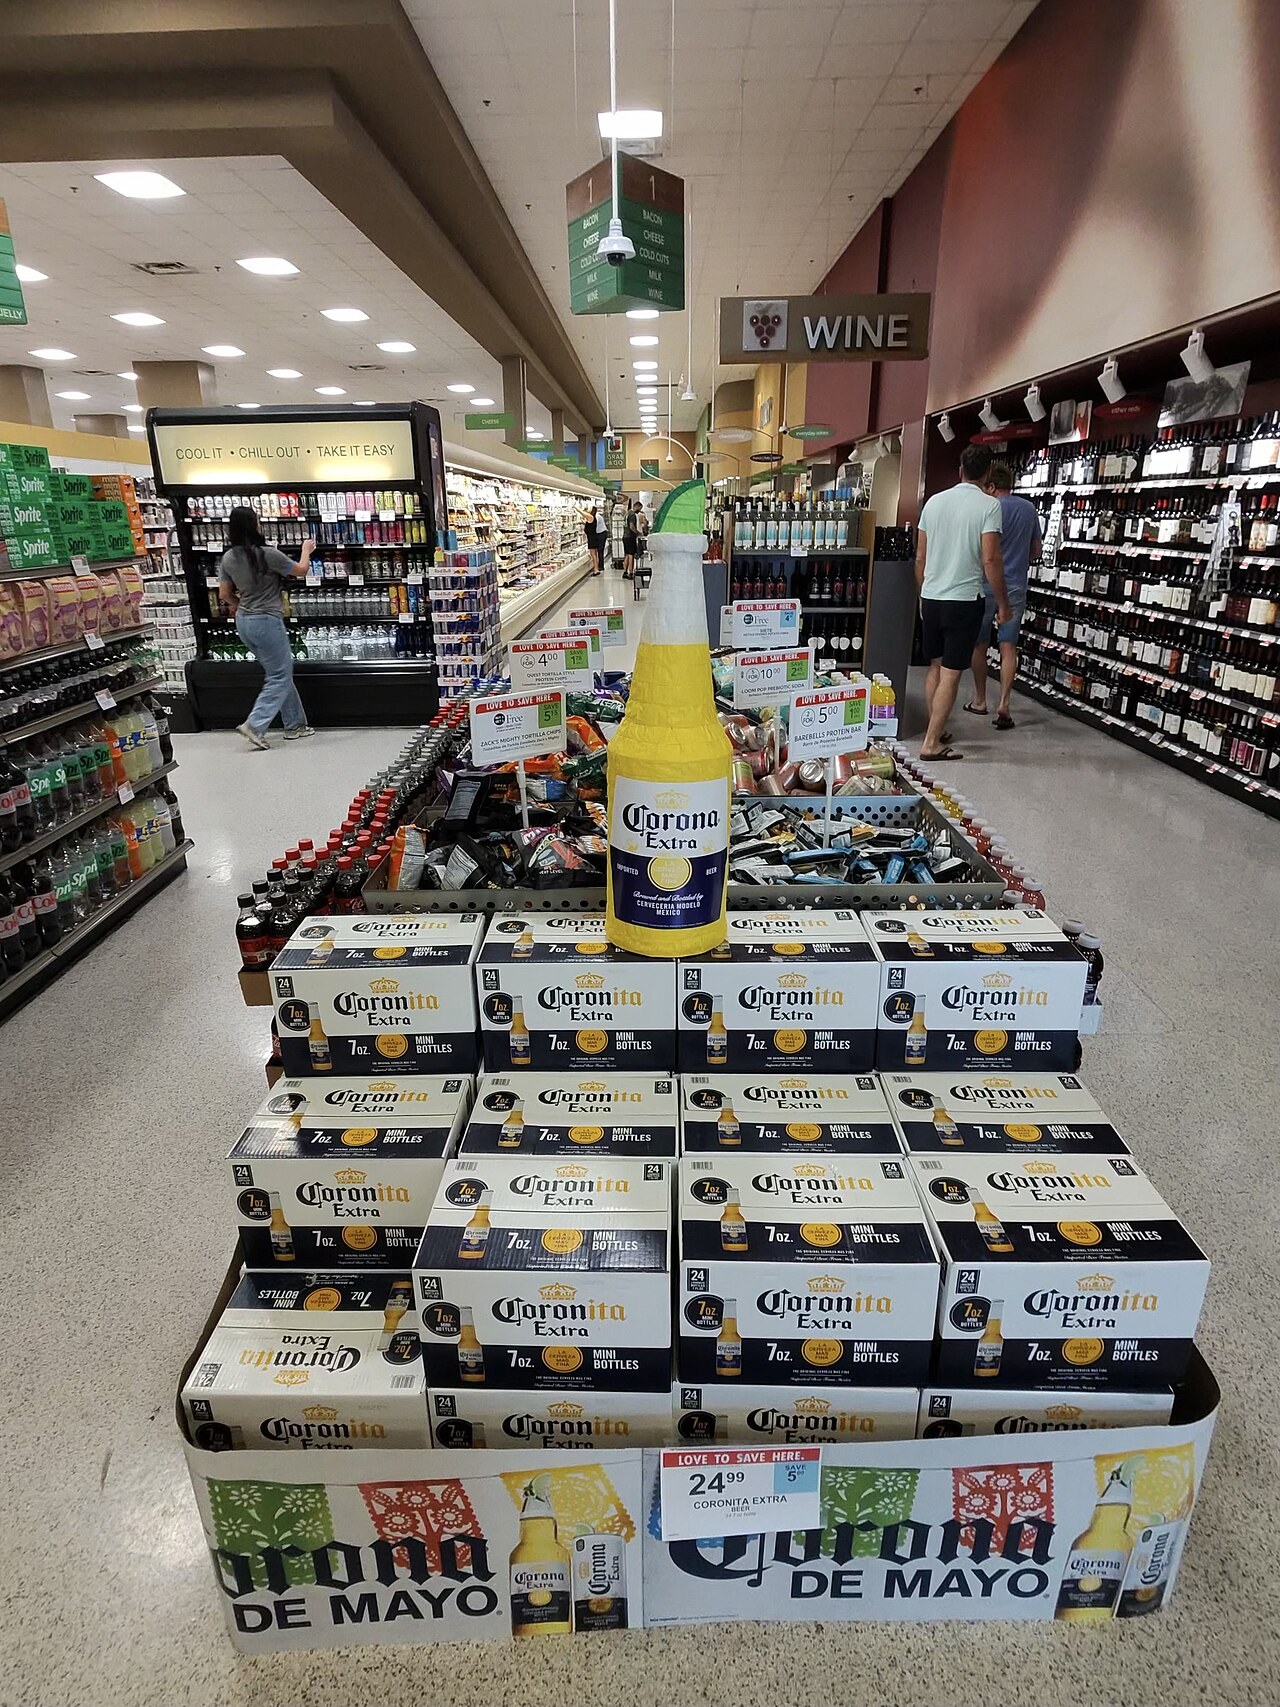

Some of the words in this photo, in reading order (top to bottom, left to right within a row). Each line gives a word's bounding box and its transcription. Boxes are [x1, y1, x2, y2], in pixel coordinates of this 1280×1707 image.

[587, 177, 593, 204] 1
[650, 175, 655, 201] 1
[583, 213, 599, 230] BACON
[643, 209, 663, 226] BACON
[583, 231, 600, 248] CHEESE
[643, 229, 665, 245] CHEESE
[581, 255, 592, 268] COLD
[639, 248, 655, 261] COLD
[656, 252, 670, 265] CUTS
[587, 272, 598, 285] MILK
[648, 270, 662, 282] MILK
[586, 290, 599, 303] WINE
[648, 288, 663, 300] WINE
[803, 314, 909, 349] WINE
[175, 448, 210, 460] COOL
[212, 448, 222, 459] IT
[239, 447, 273, 459] CHILL
[276, 447, 300, 458] OUT
[316, 446, 347, 457] TAKE
[350, 446, 360, 457] IT
[364, 445, 395, 456] EASY
[21, 476, 45, 495] Sprite
[14, 506, 41, 525] Sprite
[23, 539, 50, 558] Sprite
[844, 690, 858, 698] HERE.
[522, 732, 545, 740] TORTILLA
[546, 729, 561, 737] CHIPS
[794, 731, 825, 742] BAREBELLS
[826, 728, 850, 737] PROTEIN
[622, 802, 719, 837] Corona
[645, 831, 697, 850] Extra
[616, 863, 639, 876] IMPORTED
[706, 867, 717, 876] BEER
[633, 891, 658, 901] Brewed
[672, 892, 696, 902] Bottled
[636, 900, 675, 910] CERVECERIA
[687, 970, 698, 980] 24
[277, 979, 290, 989] 24
[334, 991, 439, 1018] Coronita
[537, 986, 642, 1012] Coronita
[738, 985, 844, 1012] Coronita
[941, 985, 1049, 1012] Coronita
[367, 1011, 412, 1026] Extra
[570, 1007, 613, 1021] Extra
[770, 1006, 813, 1021] Extra
[971, 1007, 1016, 1021] Extra
[415, 1035, 434, 1045] MINI
[1015, 1031, 1035, 1041] MINI
[416, 1043, 453, 1054] BOTTLES
[1014, 1041, 1052, 1051] BOTTLES
[324, 1089, 428, 1107] Coronita
[949, 1085, 1058, 1102] Coronita
[350, 1103, 395, 1113] Extra
[989, 1099, 1035, 1109] Extra
[509, 1174, 630, 1198] Coronita
[751, 1173, 874, 1195] Coronita
[986, 1171, 1112, 1194] Coronita
[542, 1194, 594, 1206] Extra
[791, 1191, 843, 1204] Extra
[1033, 1189, 1087, 1202] Extra
[961, 1271, 976, 1283] 24
[756, 1289, 893, 1319] Coronita
[1023, 1288, 1158, 1319] Coronita
[491, 1297, 626, 1326] Coronita
[797, 1314, 852, 1330] Extra
[1061, 1313, 1116, 1329] Extra
[534, 1321, 589, 1337] Extra
[853, 1341, 877, 1352] MINI
[239, 1344, 361, 1373] Coronita
[852, 1352, 899, 1363] BOTTLES
[501, 1413, 630, 1441] Coronita
[746, 1408, 875, 1435] Coronita
[260, 1417, 386, 1444] Coronita
[678, 1454, 708, 1466] LOVE
[714, 1453, 730, 1464] TO
[736, 1452, 766, 1463] SAVE
[772, 1451, 805, 1462] HERE.
[693, 1499, 749, 1510] CORONITA
[752, 1495, 787, 1505] EXTRA
[588, 1544, 611, 1595] Corona
[1070, 1558, 1121, 1570] Corona
[514, 1572, 564, 1585] Corona
[789, 1569, 864, 1599] DE
[882, 1567, 1049, 1599] MAYO
[232, 1598, 312, 1634] DE
[329, 1585, 499, 1625] MAYO
